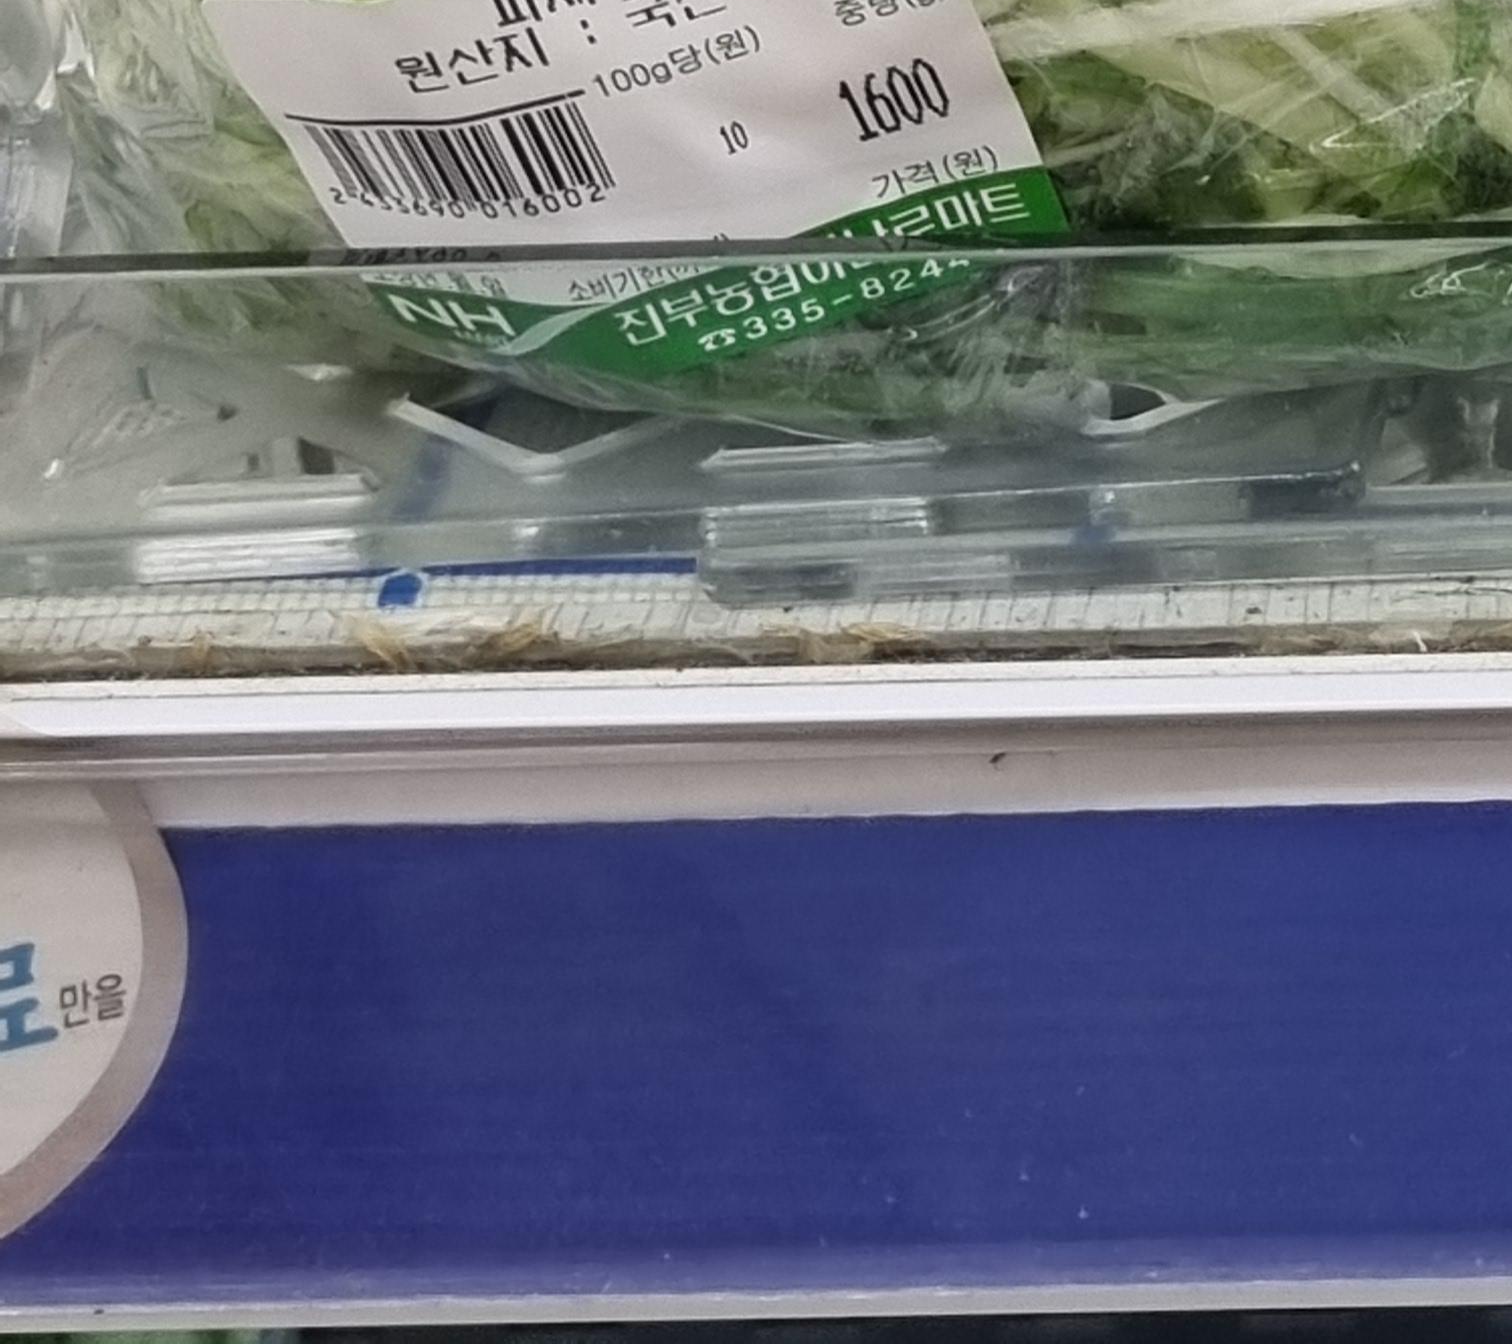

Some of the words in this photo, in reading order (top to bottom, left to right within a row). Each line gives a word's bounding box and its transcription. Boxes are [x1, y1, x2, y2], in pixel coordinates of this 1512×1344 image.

[395, 27, 550, 94] 원산지
[591, 24, 762, 98] 100g당(원)
[839, 58, 951, 143] 1600
[719, 120, 750, 155] 10
[871, 144, 999, 200] 가격(원)
[386, 292, 517, 337] NH
